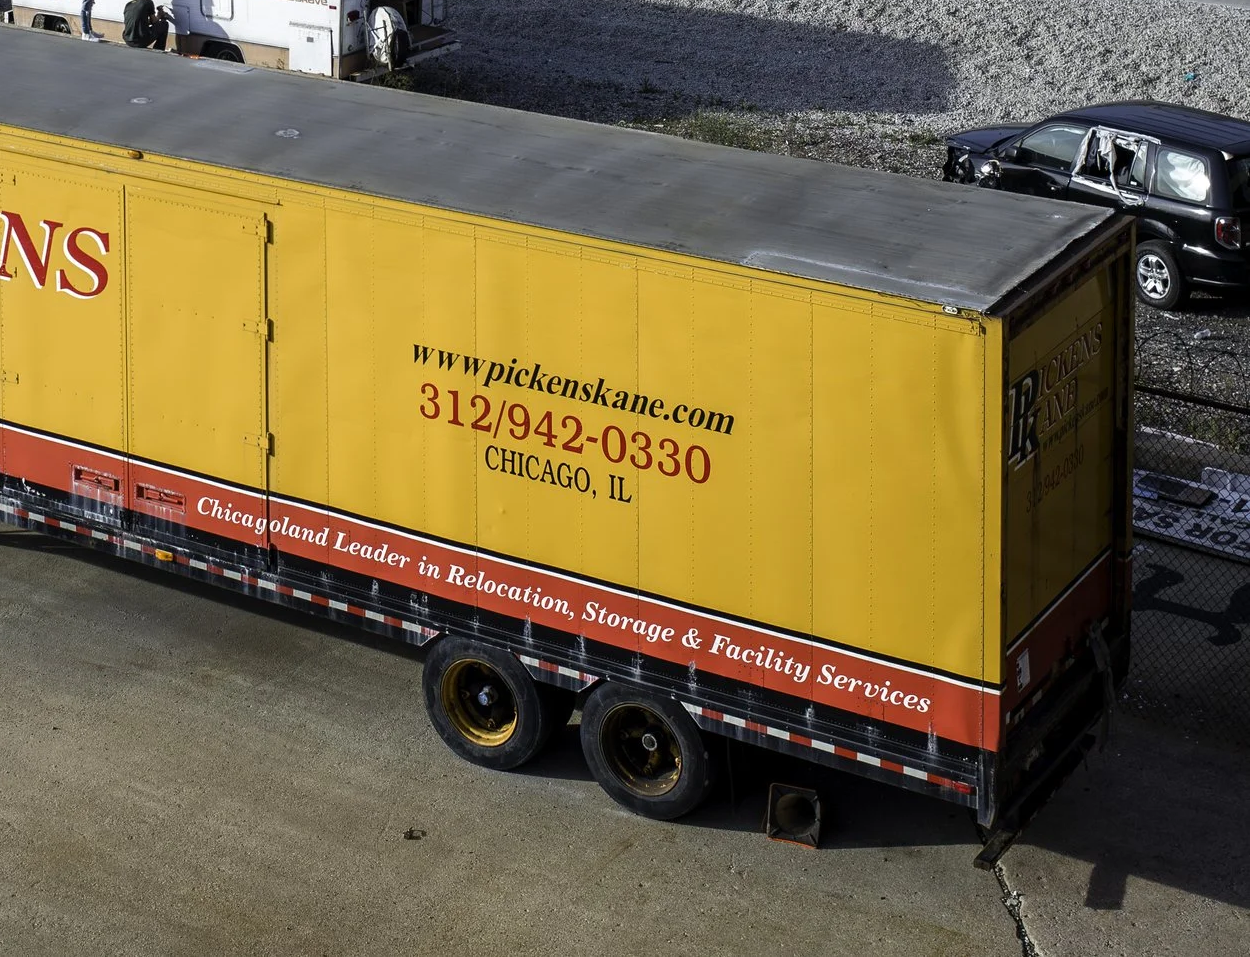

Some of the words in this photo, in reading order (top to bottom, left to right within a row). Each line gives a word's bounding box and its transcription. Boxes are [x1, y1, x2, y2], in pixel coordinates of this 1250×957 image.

[419, 382, 712, 485] 312/942-0330
[484, 444, 597, 500] CHICAGO,
[608, 474, 633, 504] IL
[196, 496, 330, 547] Chicagoland
[332, 531, 411, 569] Leader
[417, 555, 441, 580] in
[445, 564, 576, 621] Relocation,
[581, 601, 675, 644] Storage
[681, 628, 703, 650] &
[708, 633, 811, 683] Facility
[816, 664, 931, 714] Services
